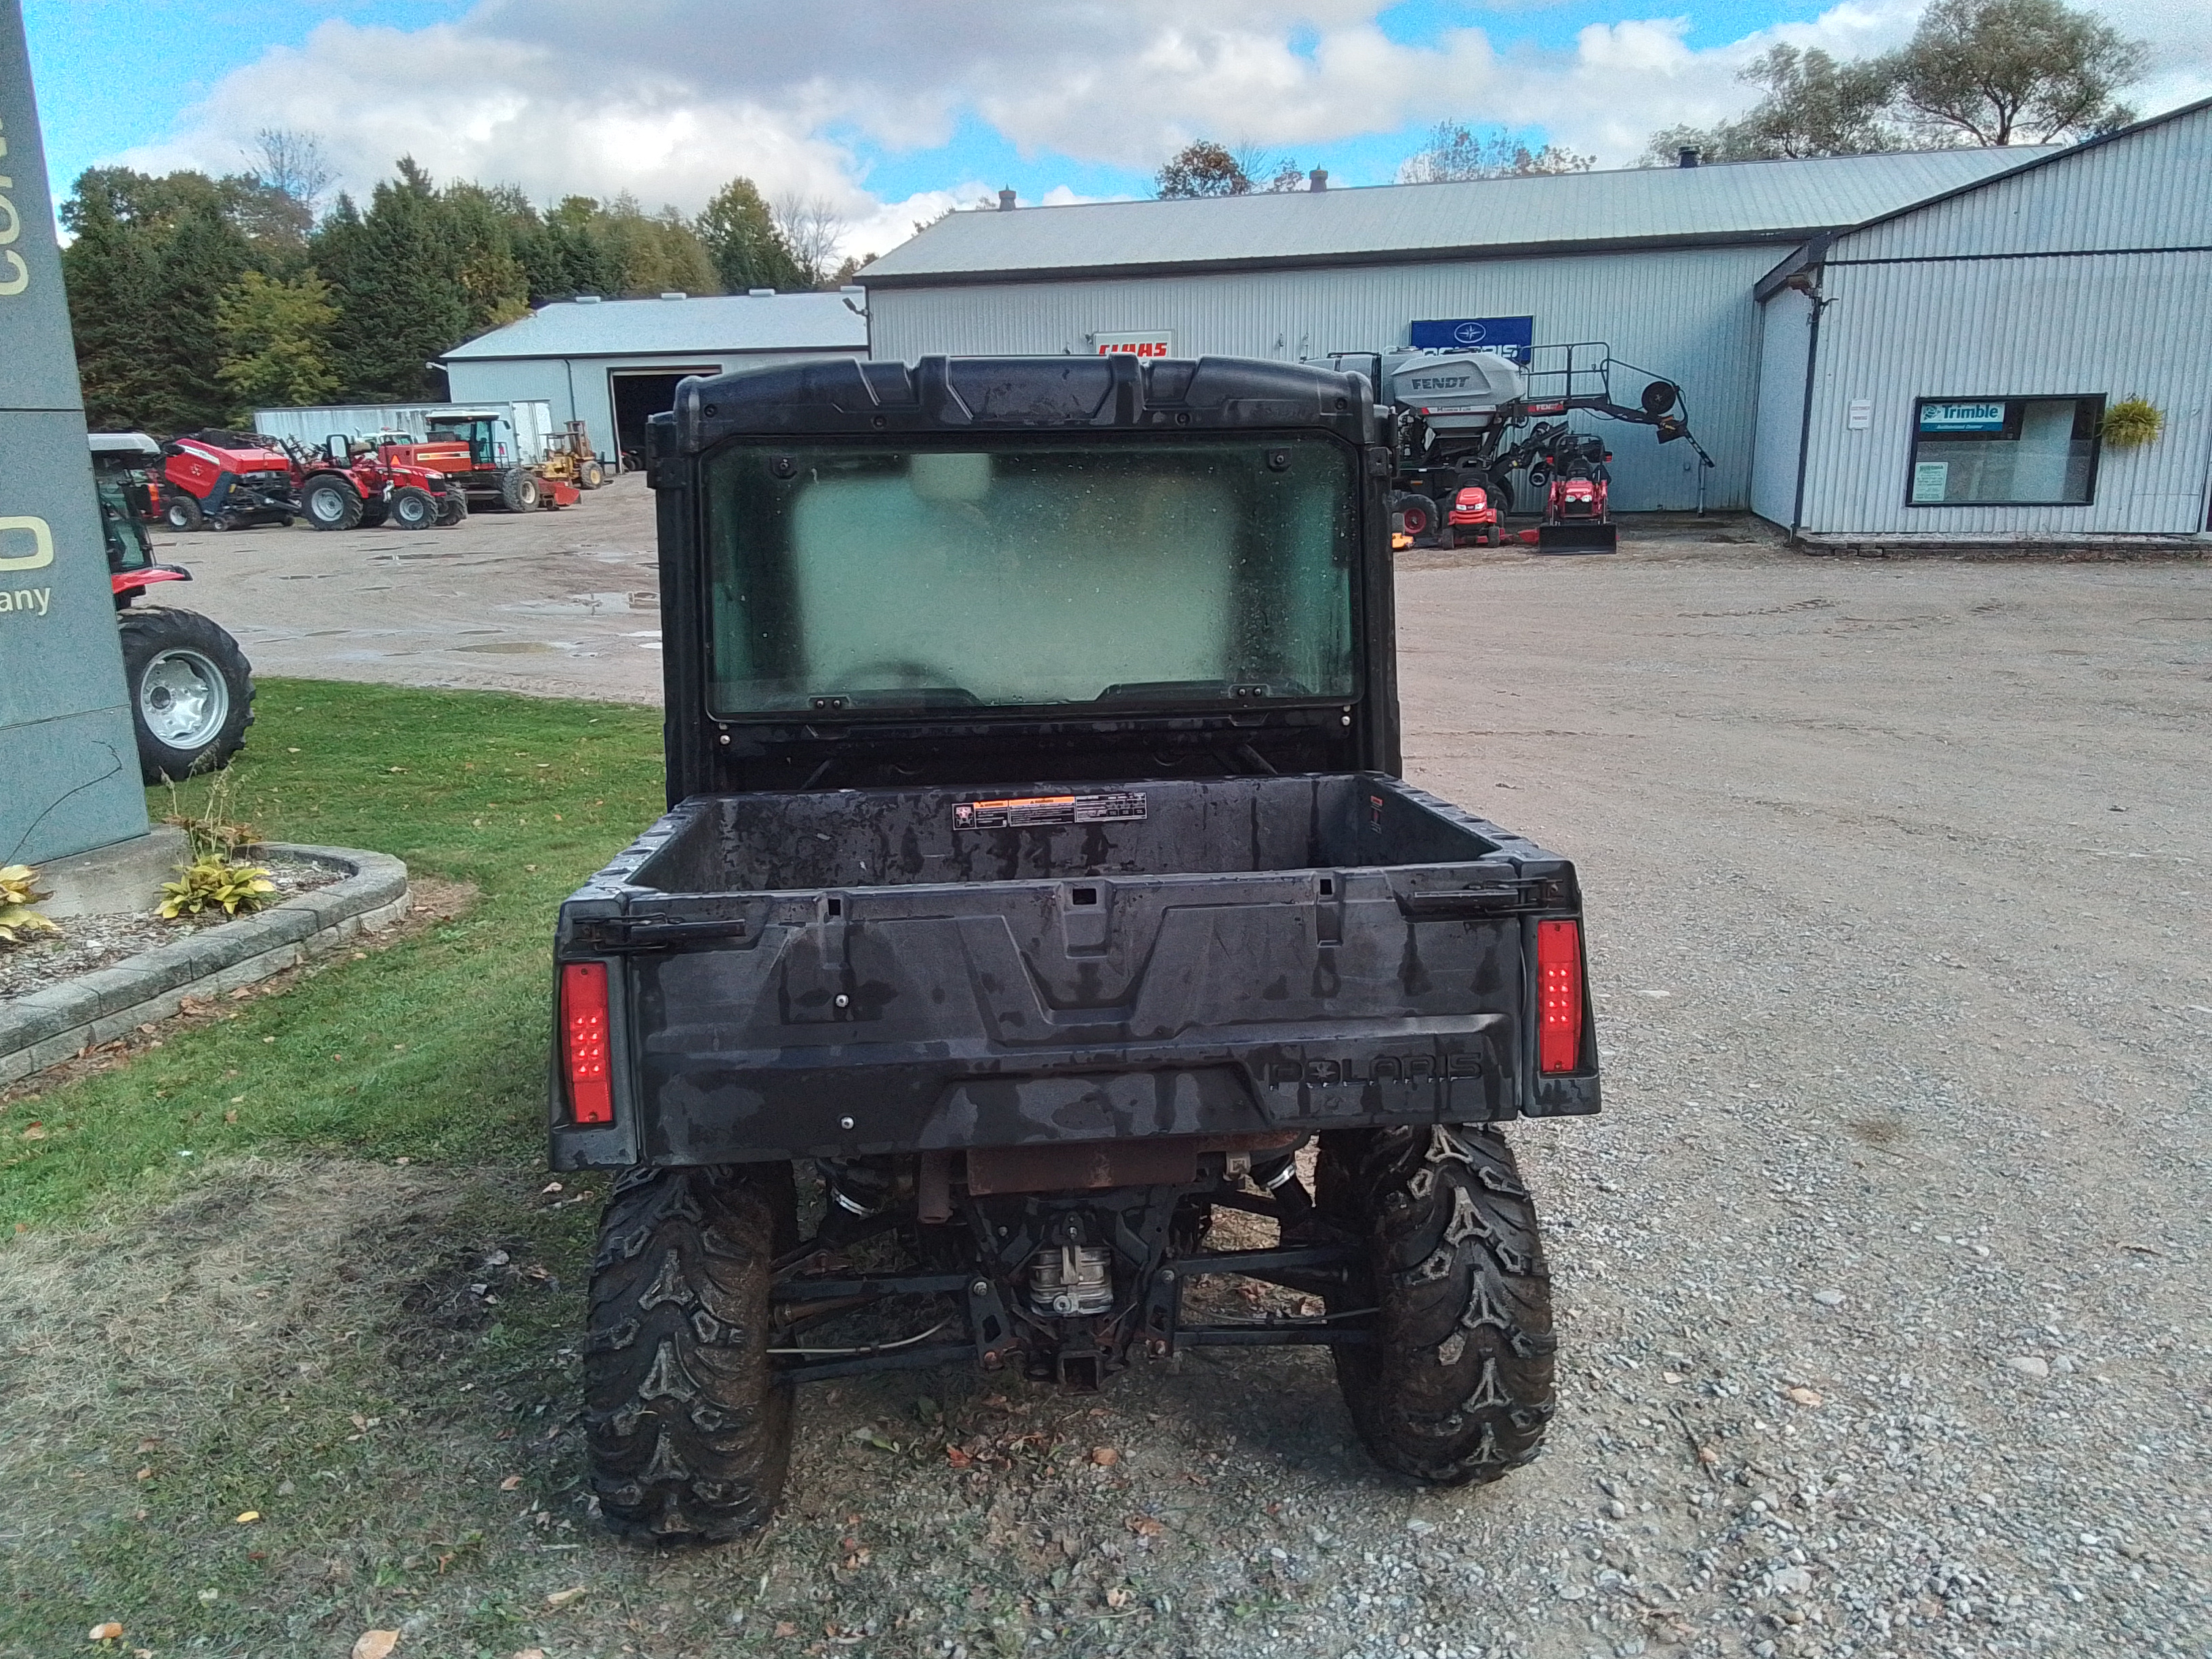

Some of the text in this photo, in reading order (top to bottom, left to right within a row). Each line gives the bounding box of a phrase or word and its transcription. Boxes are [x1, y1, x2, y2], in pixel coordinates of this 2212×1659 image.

[1412, 376, 1471, 390] FENDT
[1942, 404, 1999, 419] Trimble
[1268, 1052, 1483, 1090] POLARIS
